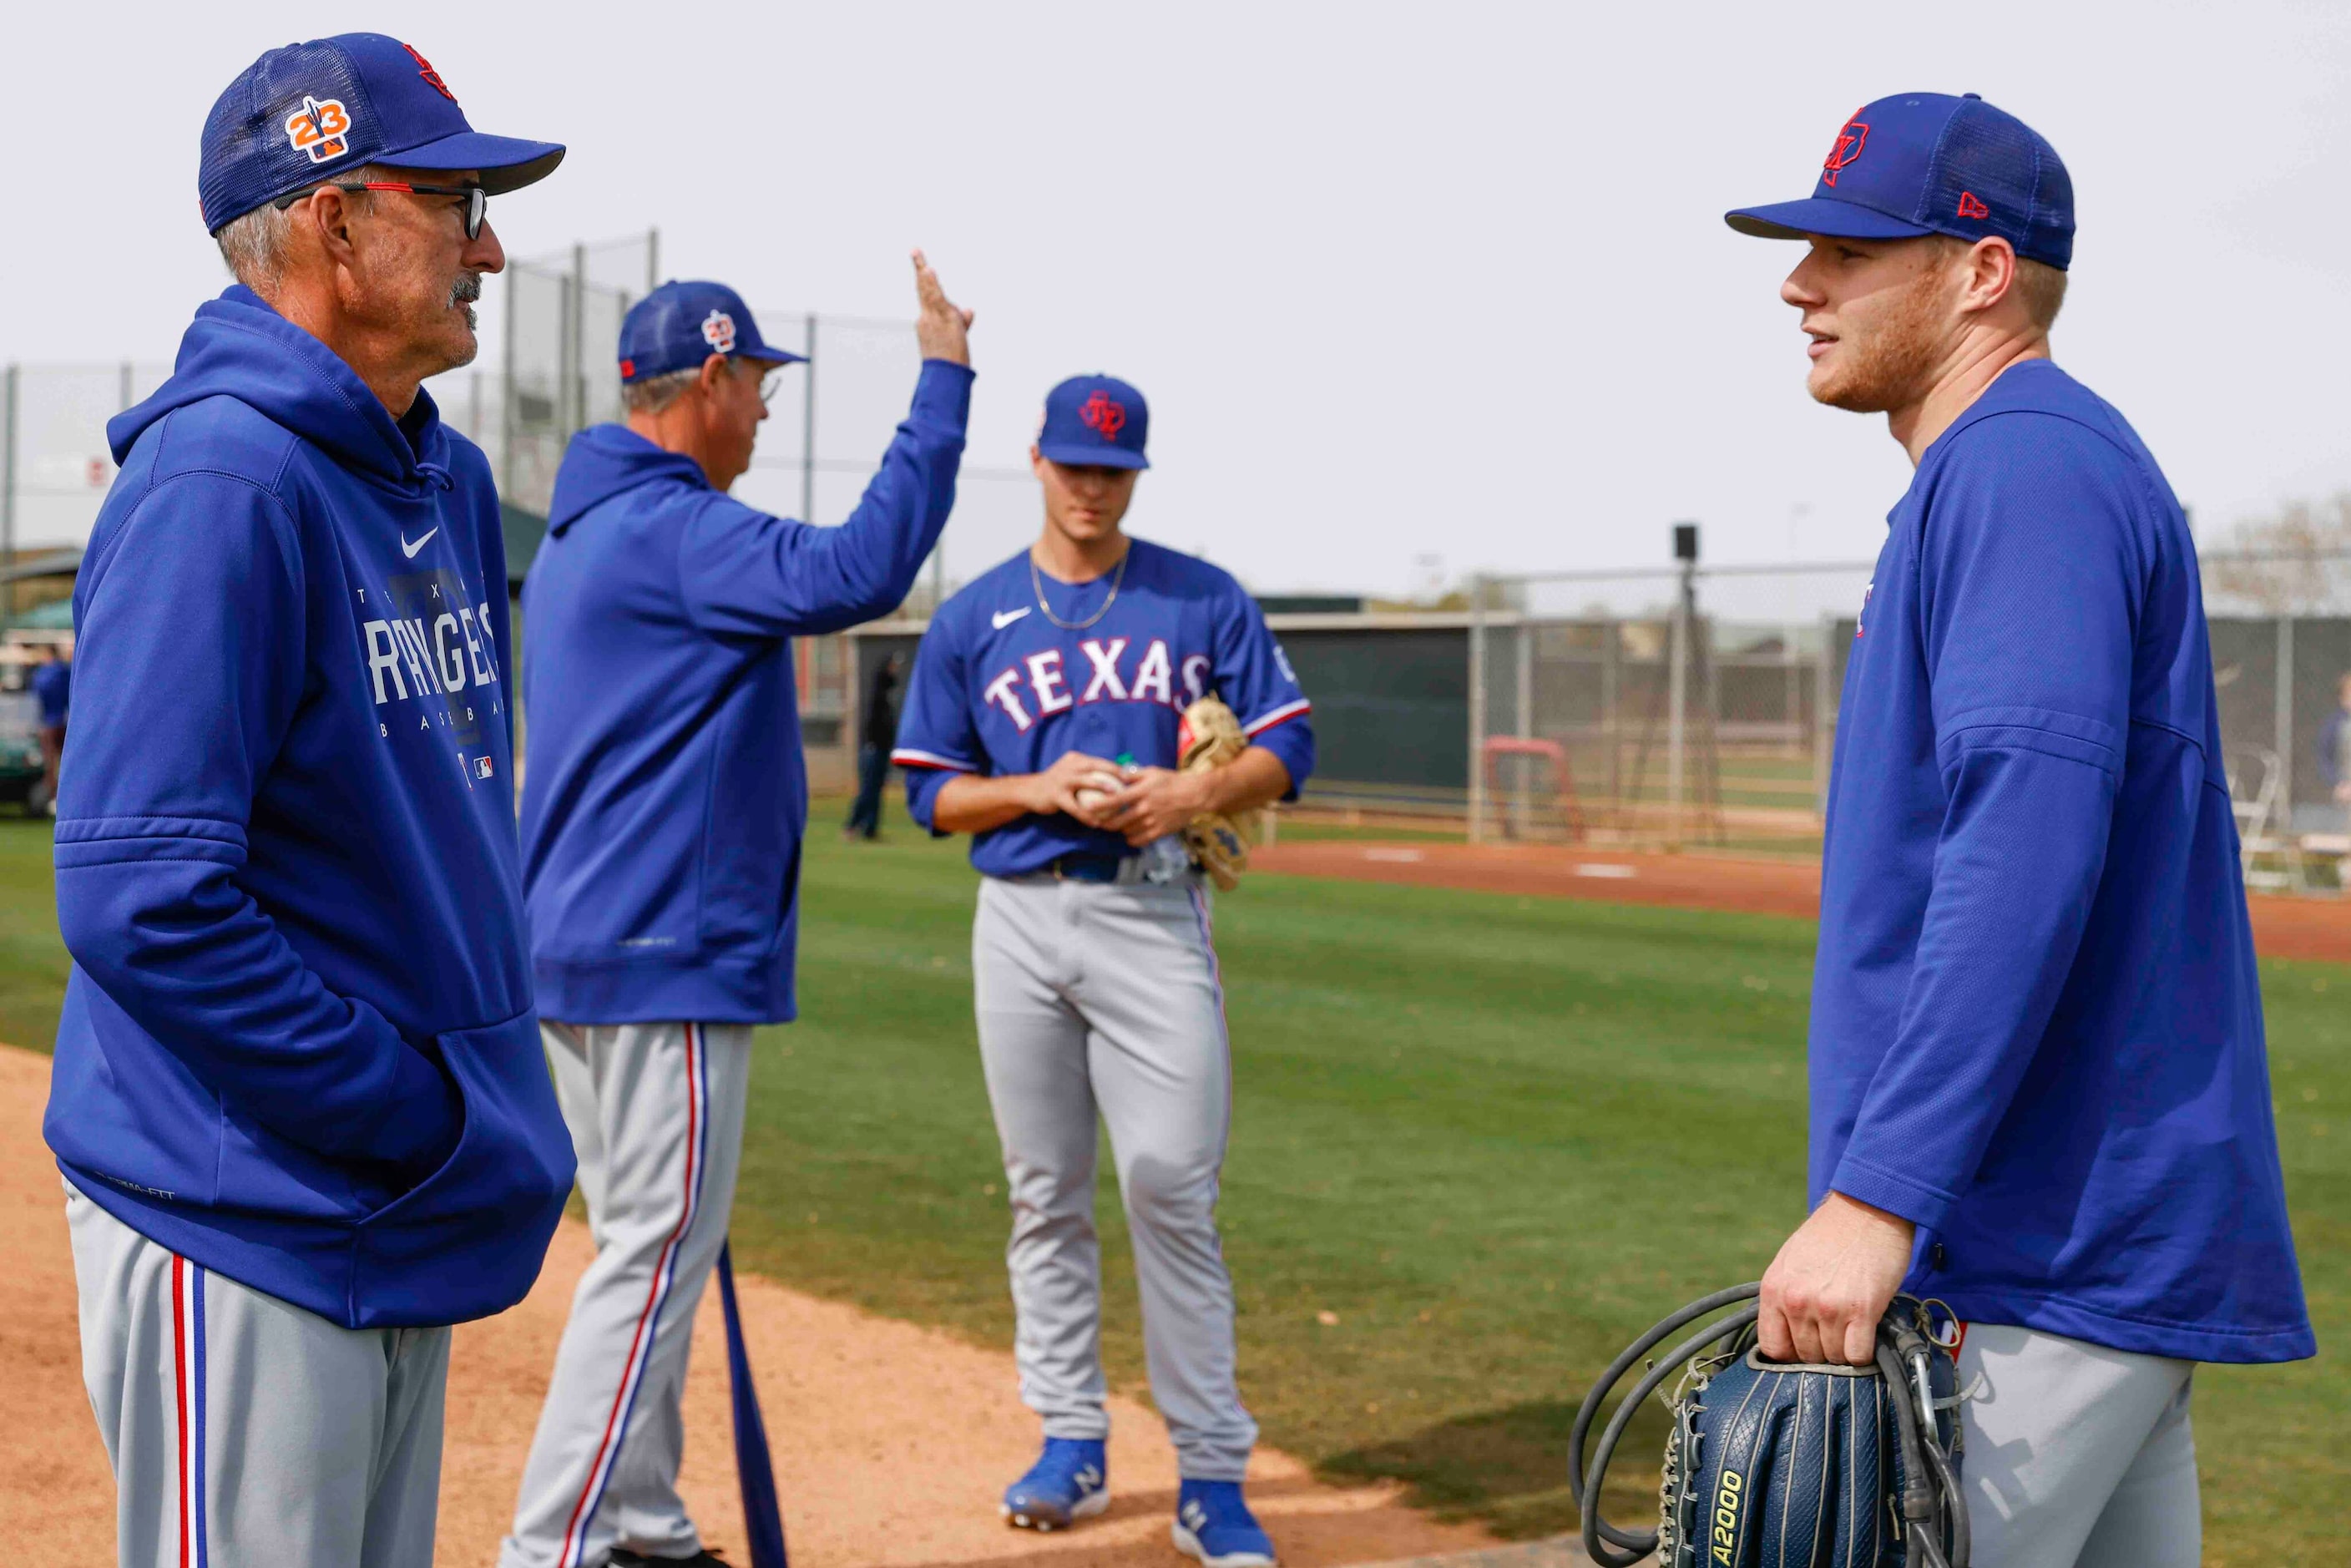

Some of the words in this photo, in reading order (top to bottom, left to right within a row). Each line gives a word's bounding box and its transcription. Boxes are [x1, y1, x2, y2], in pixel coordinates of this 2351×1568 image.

[290, 104, 347, 147] 23
[363, 601, 499, 705] RANGES
[983, 636, 1211, 736] TEXAS
[1712, 1469, 1742, 1567] A2000
